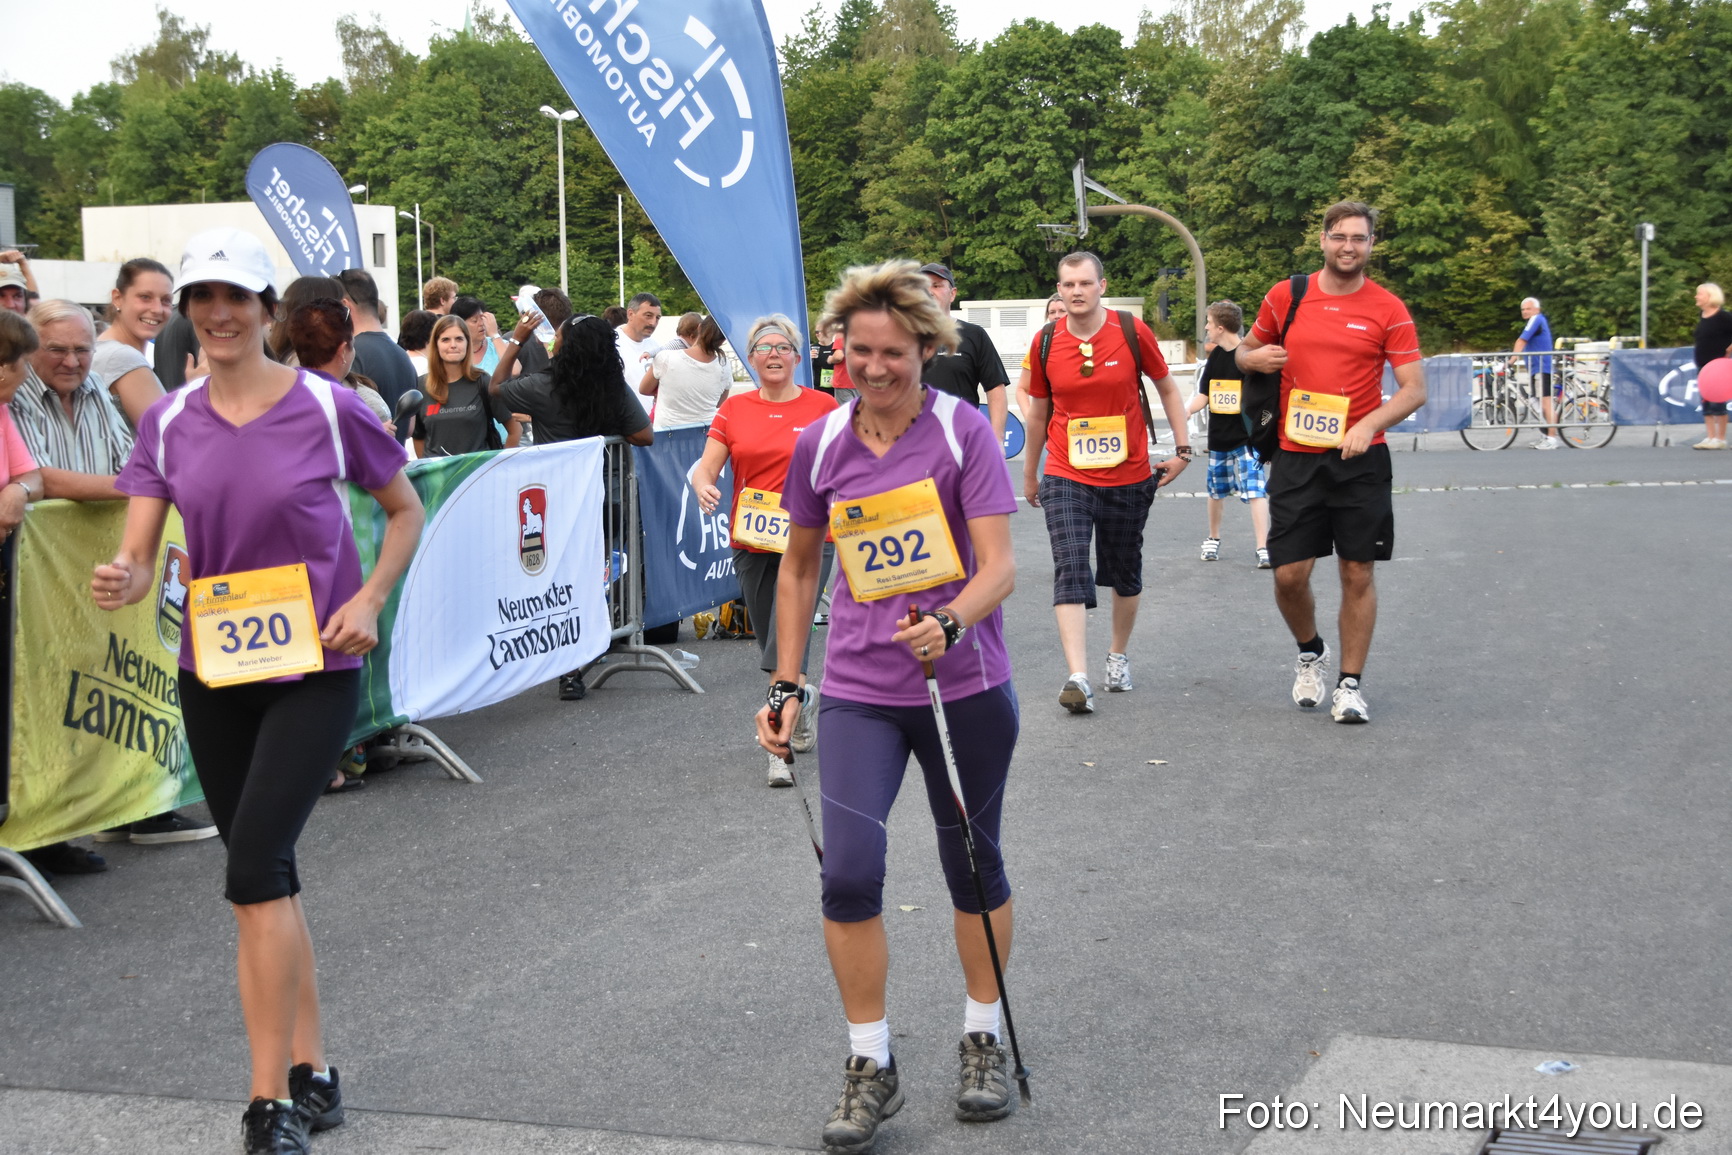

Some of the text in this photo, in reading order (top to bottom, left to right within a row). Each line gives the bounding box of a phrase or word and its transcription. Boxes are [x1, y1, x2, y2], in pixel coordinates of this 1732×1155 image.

[1213, 394, 1237, 404] 1266
[440, 404, 476, 414] duerrer.de
[1293, 412, 1339, 434] 1058
[1075, 436, 1121, 454] 1059
[743, 512, 790, 538] 1057
[843, 512, 879, 527] firmenlauf
[836, 528, 866, 540] walken
[858, 530, 931, 572] 292
[526, 553, 541, 568] 1628
[876, 576, 892, 584] Resi
[892, 568, 928, 581] Sammüller
[206, 590, 248, 605] firmenlauf
[196, 606, 230, 618] walken
[162, 621, 179, 644] 1628
[217, 612, 292, 654] 320
[238, 658, 258, 668] Marie
[259, 655, 282, 664] Weber
